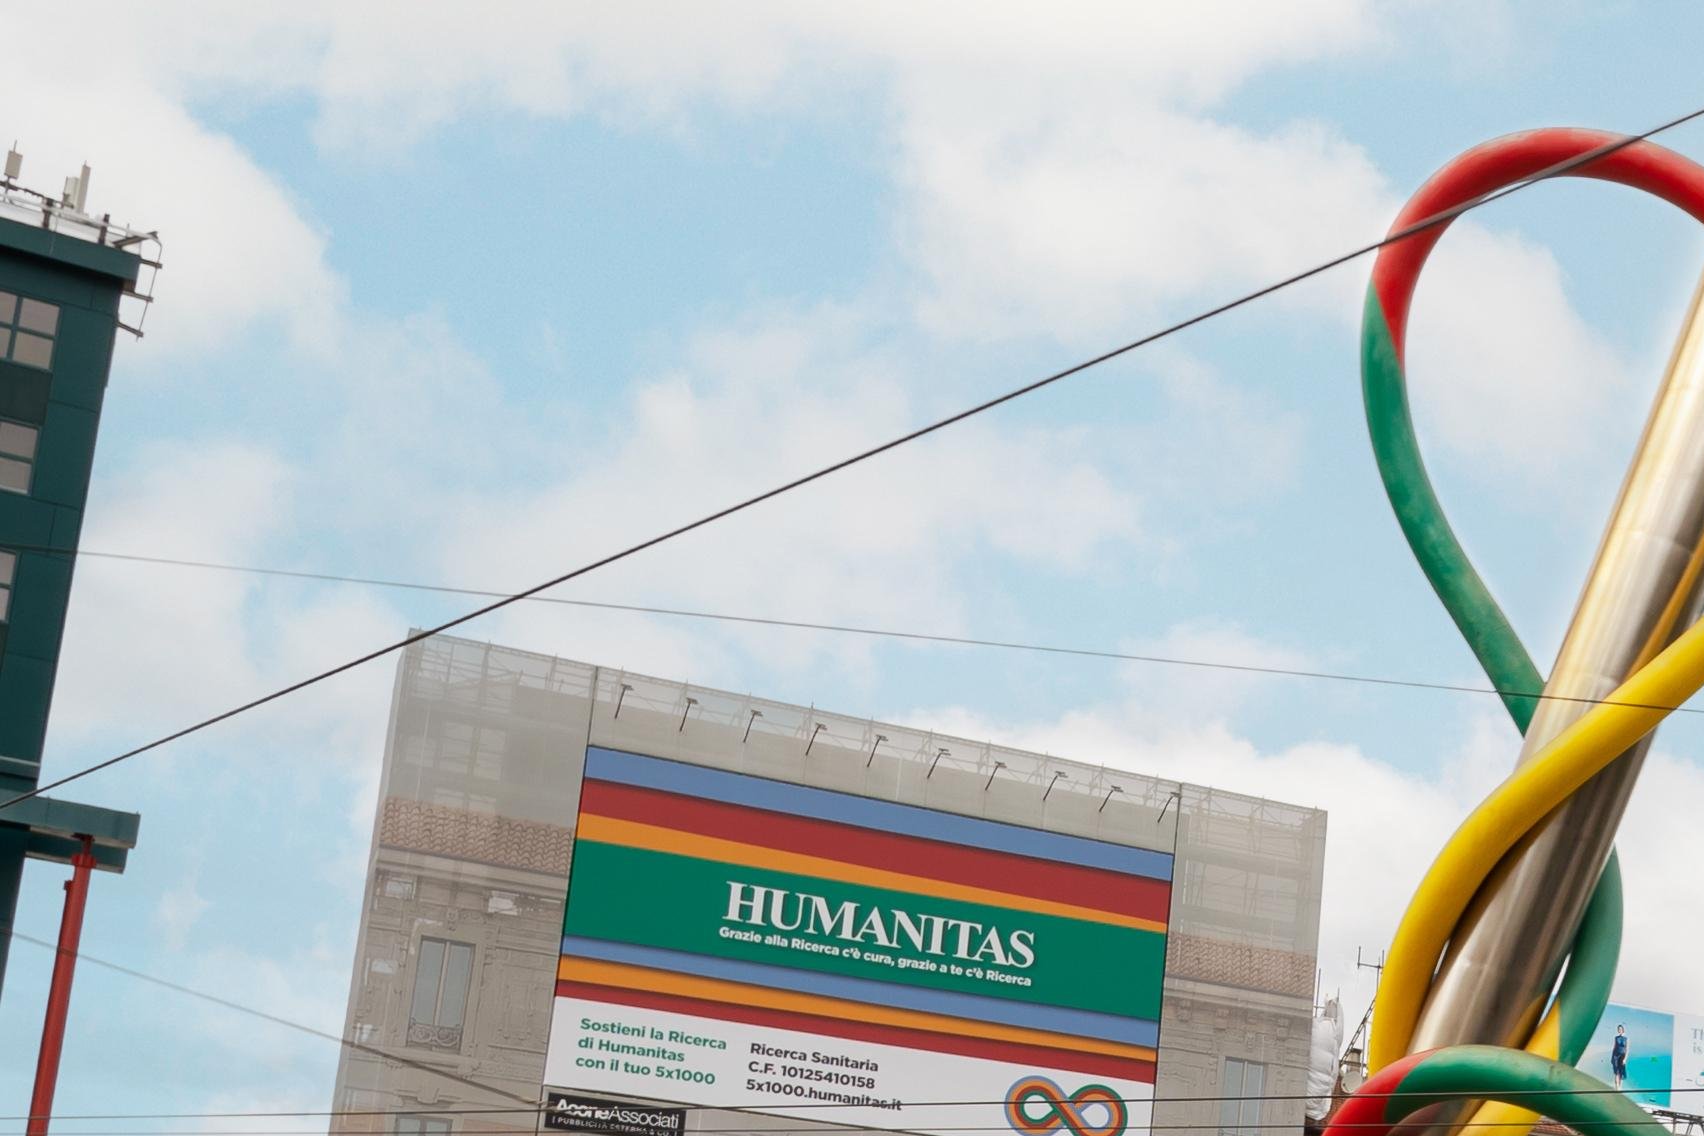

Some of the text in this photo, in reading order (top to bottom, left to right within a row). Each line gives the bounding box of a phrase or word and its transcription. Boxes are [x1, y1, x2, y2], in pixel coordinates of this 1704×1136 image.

[721, 880, 1035, 969] HUMANITAS
[719, 926, 762, 943] Grazie
[764, 933, 788, 948] alla
[791, 938, 840, 957] Ricerca
[864, 952, 895, 966] cura,
[898, 956, 937, 973] grazie
[939, 964, 948, 974] a
[949, 964, 964, 976] te
[986, 969, 1032, 986] Ricerca
[580, 1018, 727, 1050] Sostieni la Ricerca
[1693, 1042, 1703, 1054] is
[578, 1037, 685, 1062] di Humanitas
[749, 1043, 879, 1072] Ricerca Sanitaria
[575, 1057, 715, 1085] con il tuo 5x1000
[748, 1061, 875, 1089] C.F. 10125410158
[746, 1079, 902, 1111] 5x1000.humanitas.it
